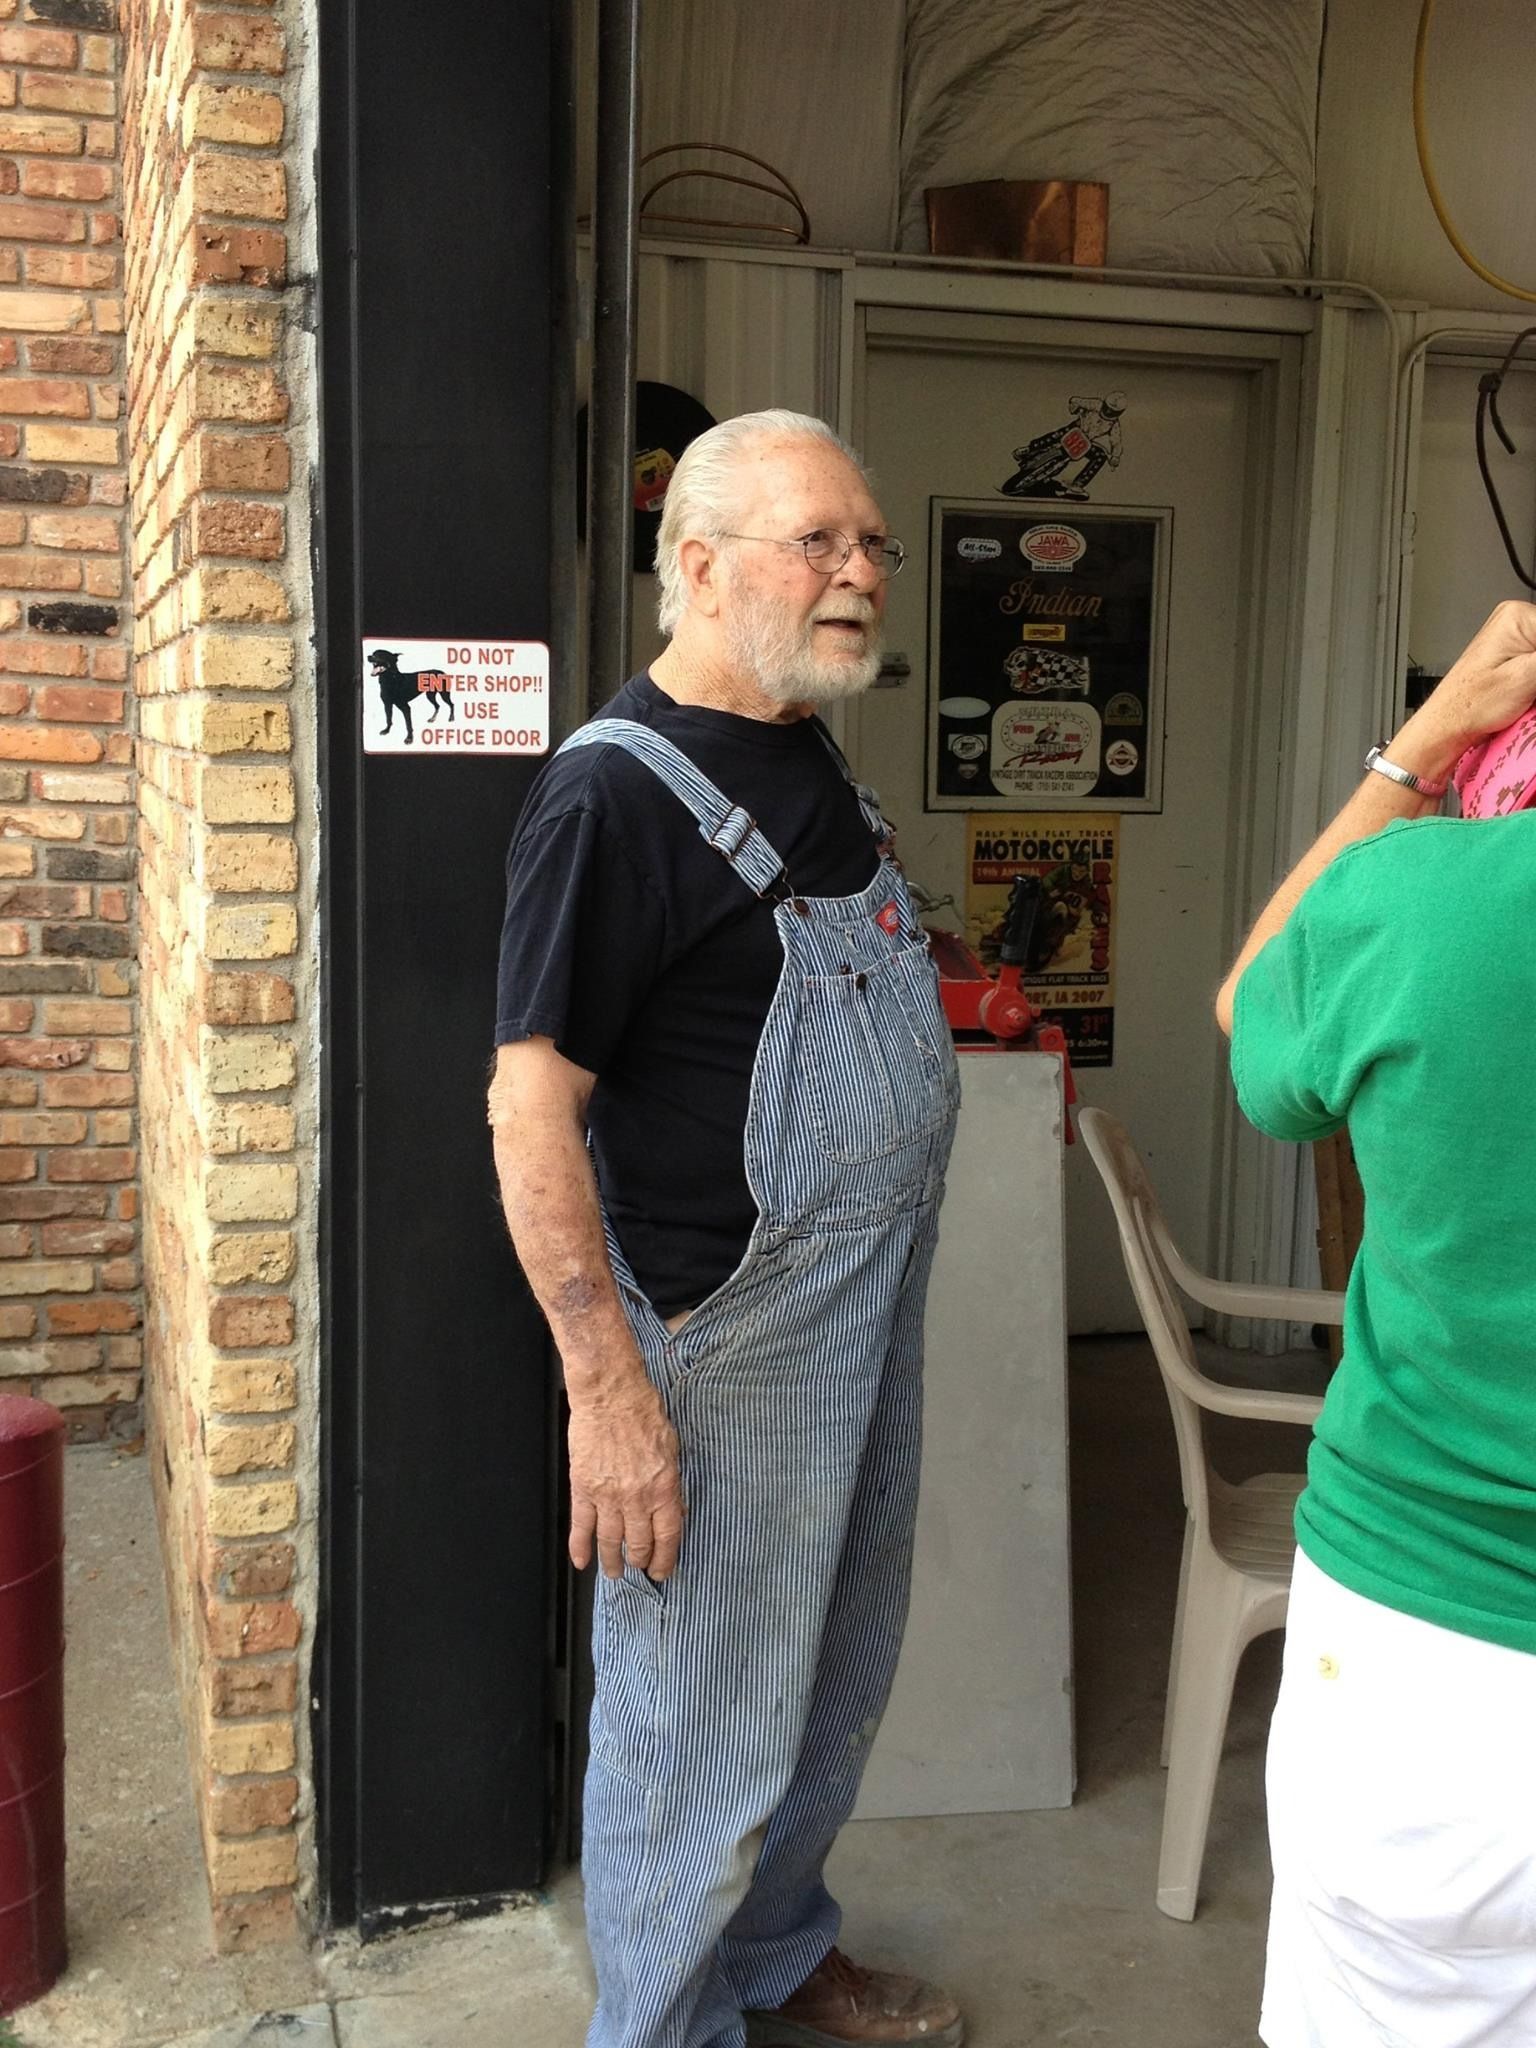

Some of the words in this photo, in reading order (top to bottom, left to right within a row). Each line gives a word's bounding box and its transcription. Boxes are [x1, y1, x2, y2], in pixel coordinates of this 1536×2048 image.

[1038, 535, 1070, 546] JAWA
[999, 575, 1103, 616] Indian
[447, 647, 472, 665] DO
[478, 648, 515, 665] NOT
[417, 673, 478, 692] ENTER
[484, 675, 543, 693] SHOP!!
[464, 702, 500, 719] USE
[421, 728, 485, 745] OFFICE
[491, 729, 541, 746] DOOR
[975, 830, 1004, 838] HALF
[1012, 830, 1038, 838] MILE
[1045, 830, 1071, 838] FLAT
[1079, 830, 1113, 838] TRACK
[974, 839, 1113, 860] MOTORCYCLE
[1024, 991, 1052, 1006] ORT,
[1055, 991, 1068, 1003] IA
[1071, 990, 1105, 1004] 2007
